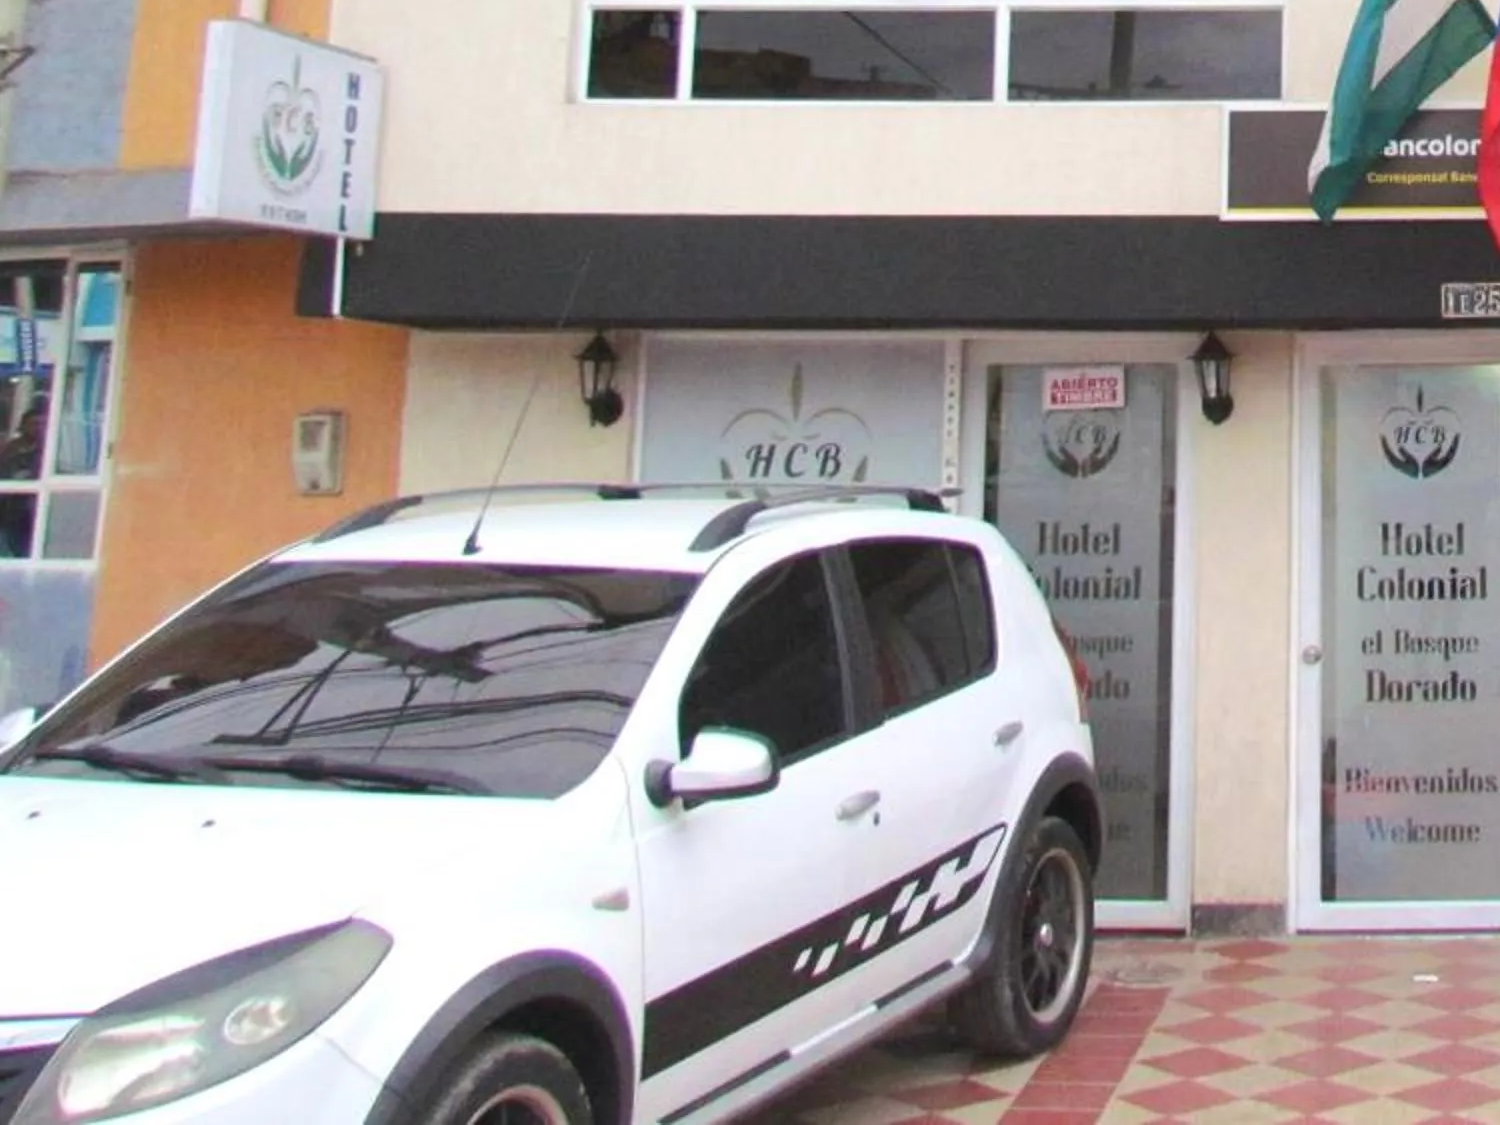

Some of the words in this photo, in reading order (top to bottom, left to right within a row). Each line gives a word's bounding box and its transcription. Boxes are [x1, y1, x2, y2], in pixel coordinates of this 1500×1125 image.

[338, 72, 361, 232] HOTEL
[745, 442, 842, 479] HCB
[1038, 520, 1121, 557] Hotel
[1380, 522, 1465, 557] Hotel
[1028, 564, 1142, 602] olonial
[1356, 565, 1488, 602] Colonial
[1361, 629, 1383, 656] el
[1394, 628, 1480, 662] Bosque
[1365, 669, 1478, 703] Dorado
[1344, 767, 1499, 795] Bienvenidos
[1364, 816, 1482, 844] Welcome
